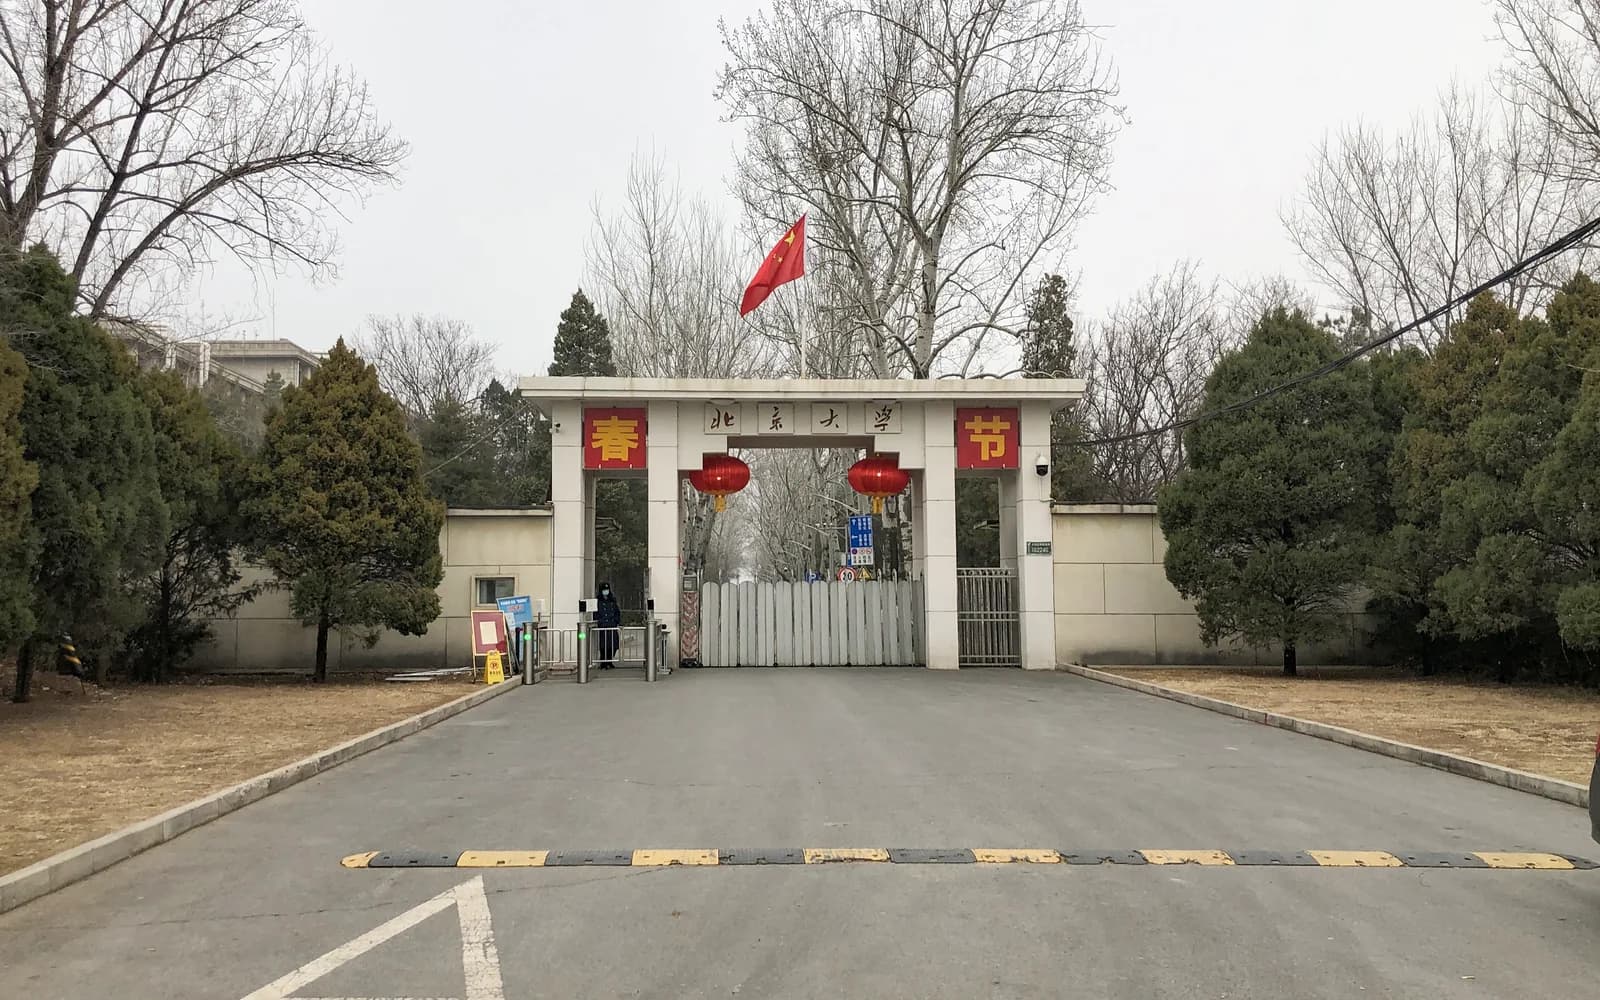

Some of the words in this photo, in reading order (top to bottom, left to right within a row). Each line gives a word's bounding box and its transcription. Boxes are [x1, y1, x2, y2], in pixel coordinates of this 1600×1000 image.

[591, 415, 639, 462] 春
[964, 415, 1011, 461] 节
[842, 571, 852, 581] 20
